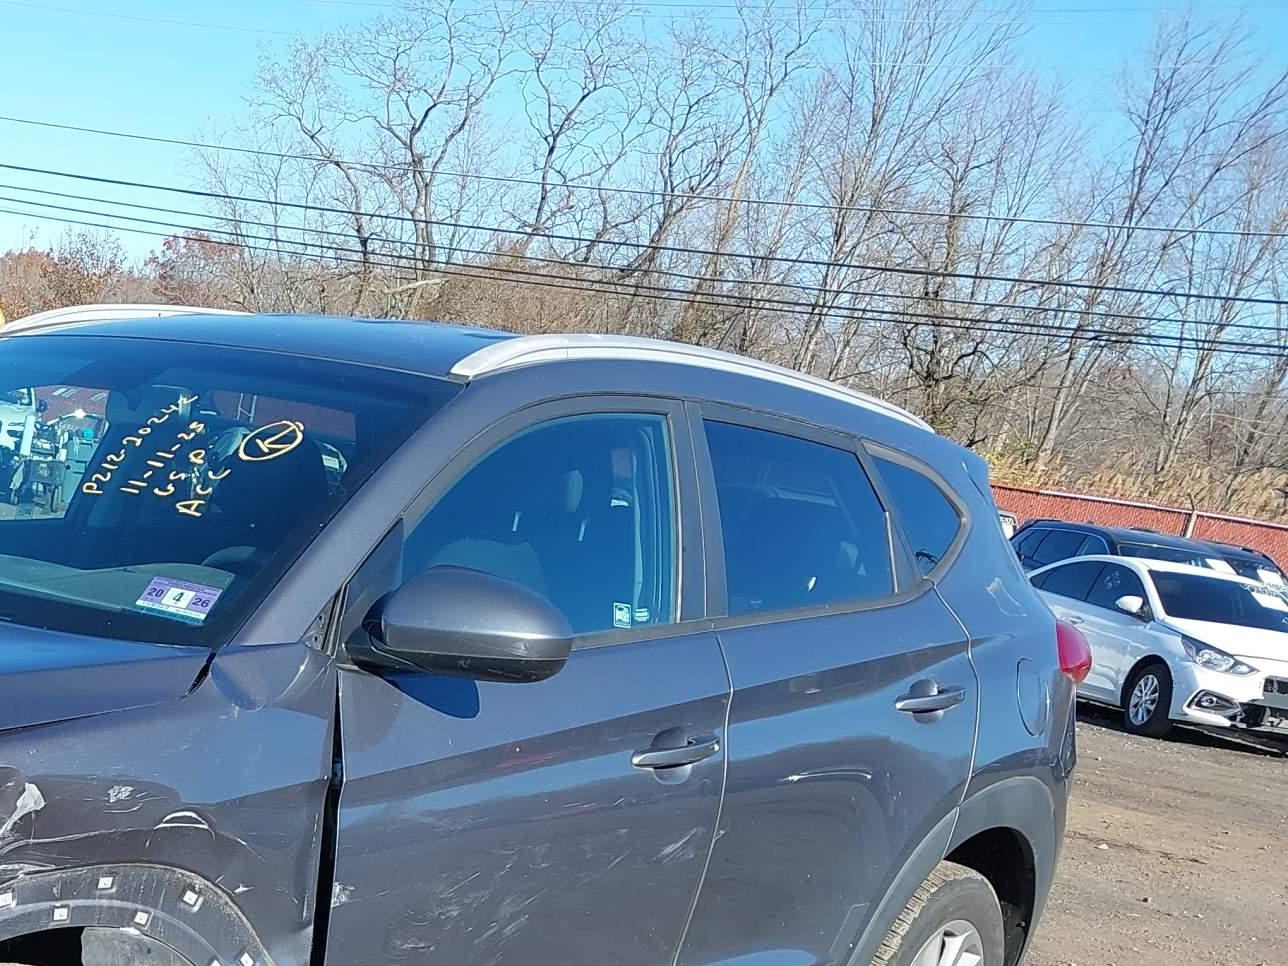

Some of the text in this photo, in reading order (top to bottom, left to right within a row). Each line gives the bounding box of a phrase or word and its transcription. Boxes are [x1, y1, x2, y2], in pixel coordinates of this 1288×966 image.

[147, 587, 210, 608] 20 4 26
